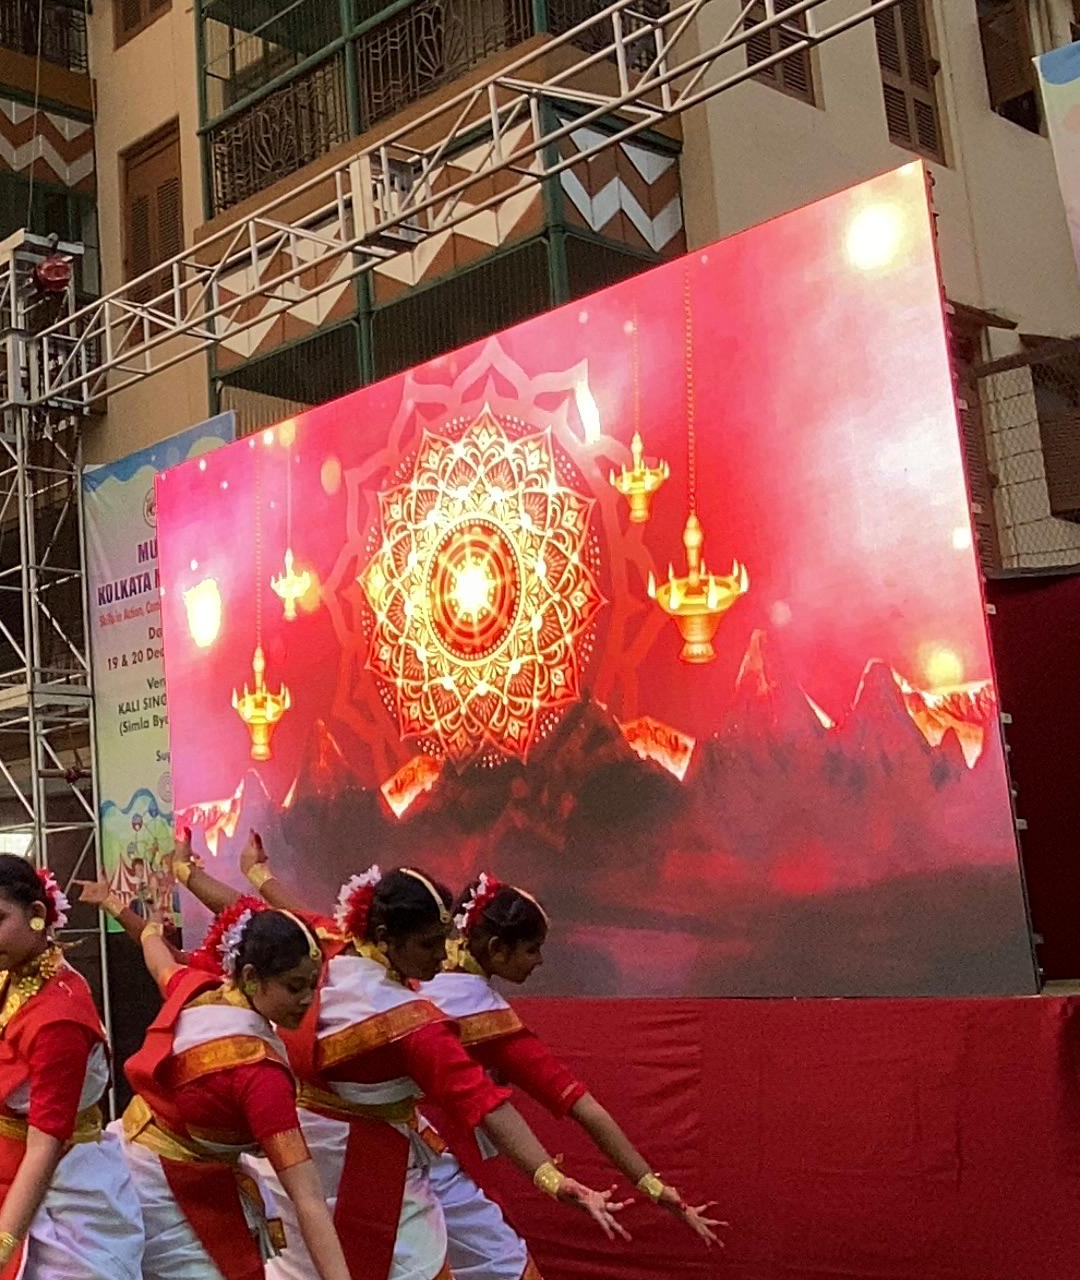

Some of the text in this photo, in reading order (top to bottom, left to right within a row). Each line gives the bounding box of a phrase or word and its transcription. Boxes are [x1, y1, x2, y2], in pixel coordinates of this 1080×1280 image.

[98, 572, 152, 606] KOLKATA
[108, 657, 118, 671] 19
[121, 654, 128, 667] &
[132, 650, 143, 664] 20
[119, 699, 139, 715] KALI
